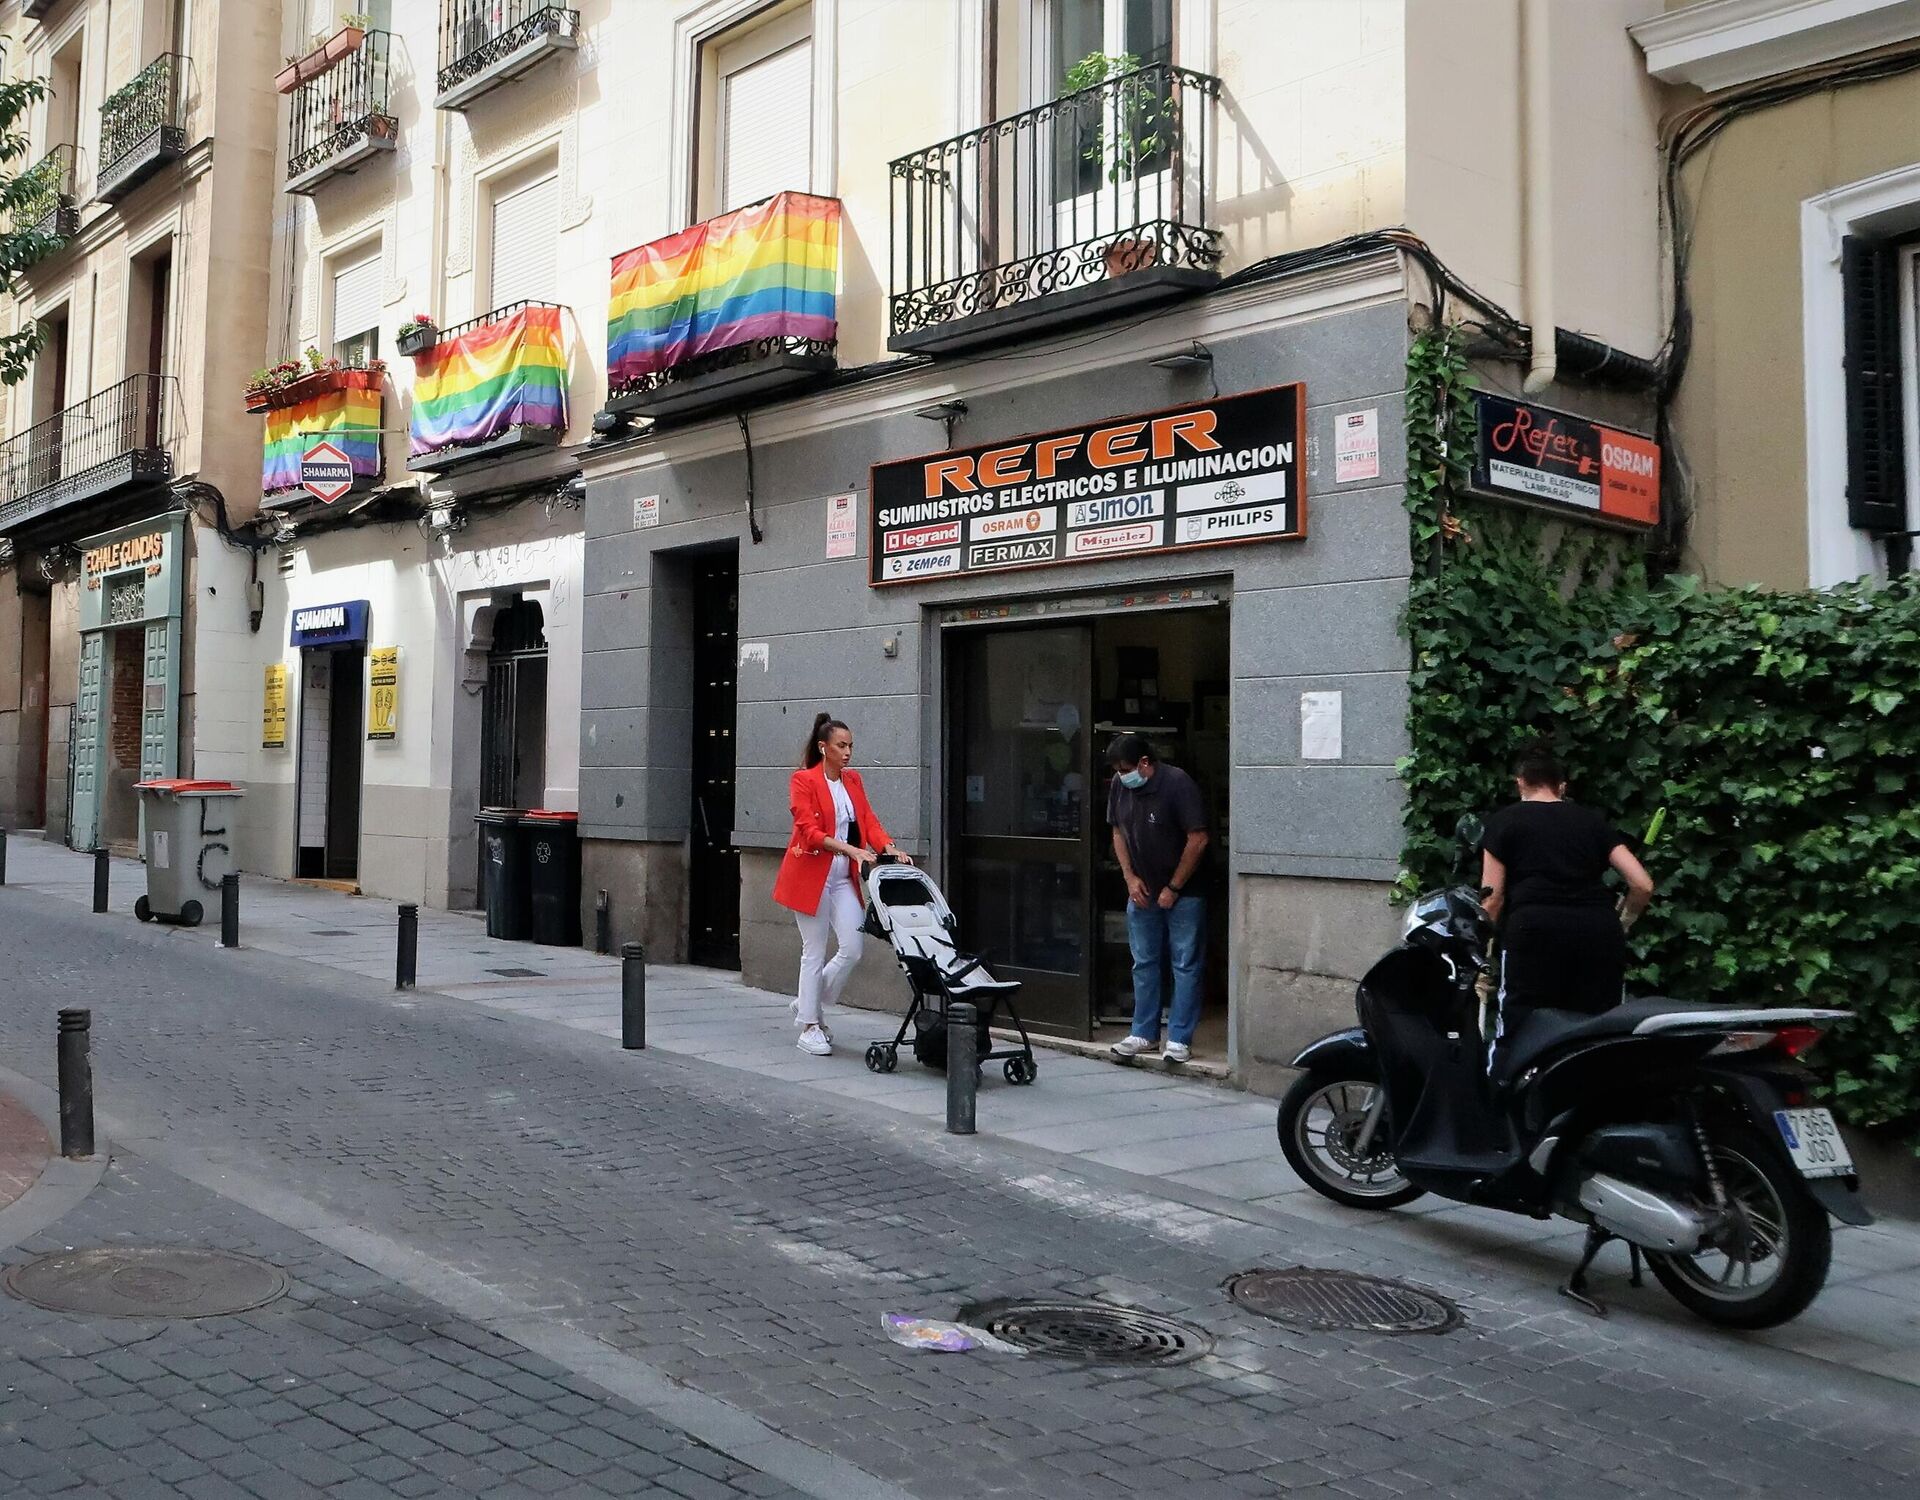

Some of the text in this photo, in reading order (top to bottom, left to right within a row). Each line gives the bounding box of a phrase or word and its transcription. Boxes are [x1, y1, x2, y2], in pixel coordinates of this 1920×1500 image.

[1493, 407, 1578, 467] Refer
[924, 409, 1223, 499] REFER
[1602, 443, 1654, 478] OSRAM
[303, 467, 349, 477] SHAWARMA
[1491, 462, 1546, 483] MATERIALES
[1549, 476, 1599, 496] ELECTRICOS
[878, 493, 994, 527] SUMINISTROS
[999, 471, 1118, 509] ELECTRICOS
[1124, 469, 1137, 489] E
[1144, 441, 1293, 487] ILUMINACION
[982, 518, 1023, 533] OSRAM
[1207, 510, 1273, 529] PHILIPS
[902, 525, 958, 547] legrand
[497, 547, 510, 565] 49
[906, 554, 951, 572] ZEMPER
[973, 541, 1050, 563] FERMAX
[295, 607, 345, 631] SHAWARMA
